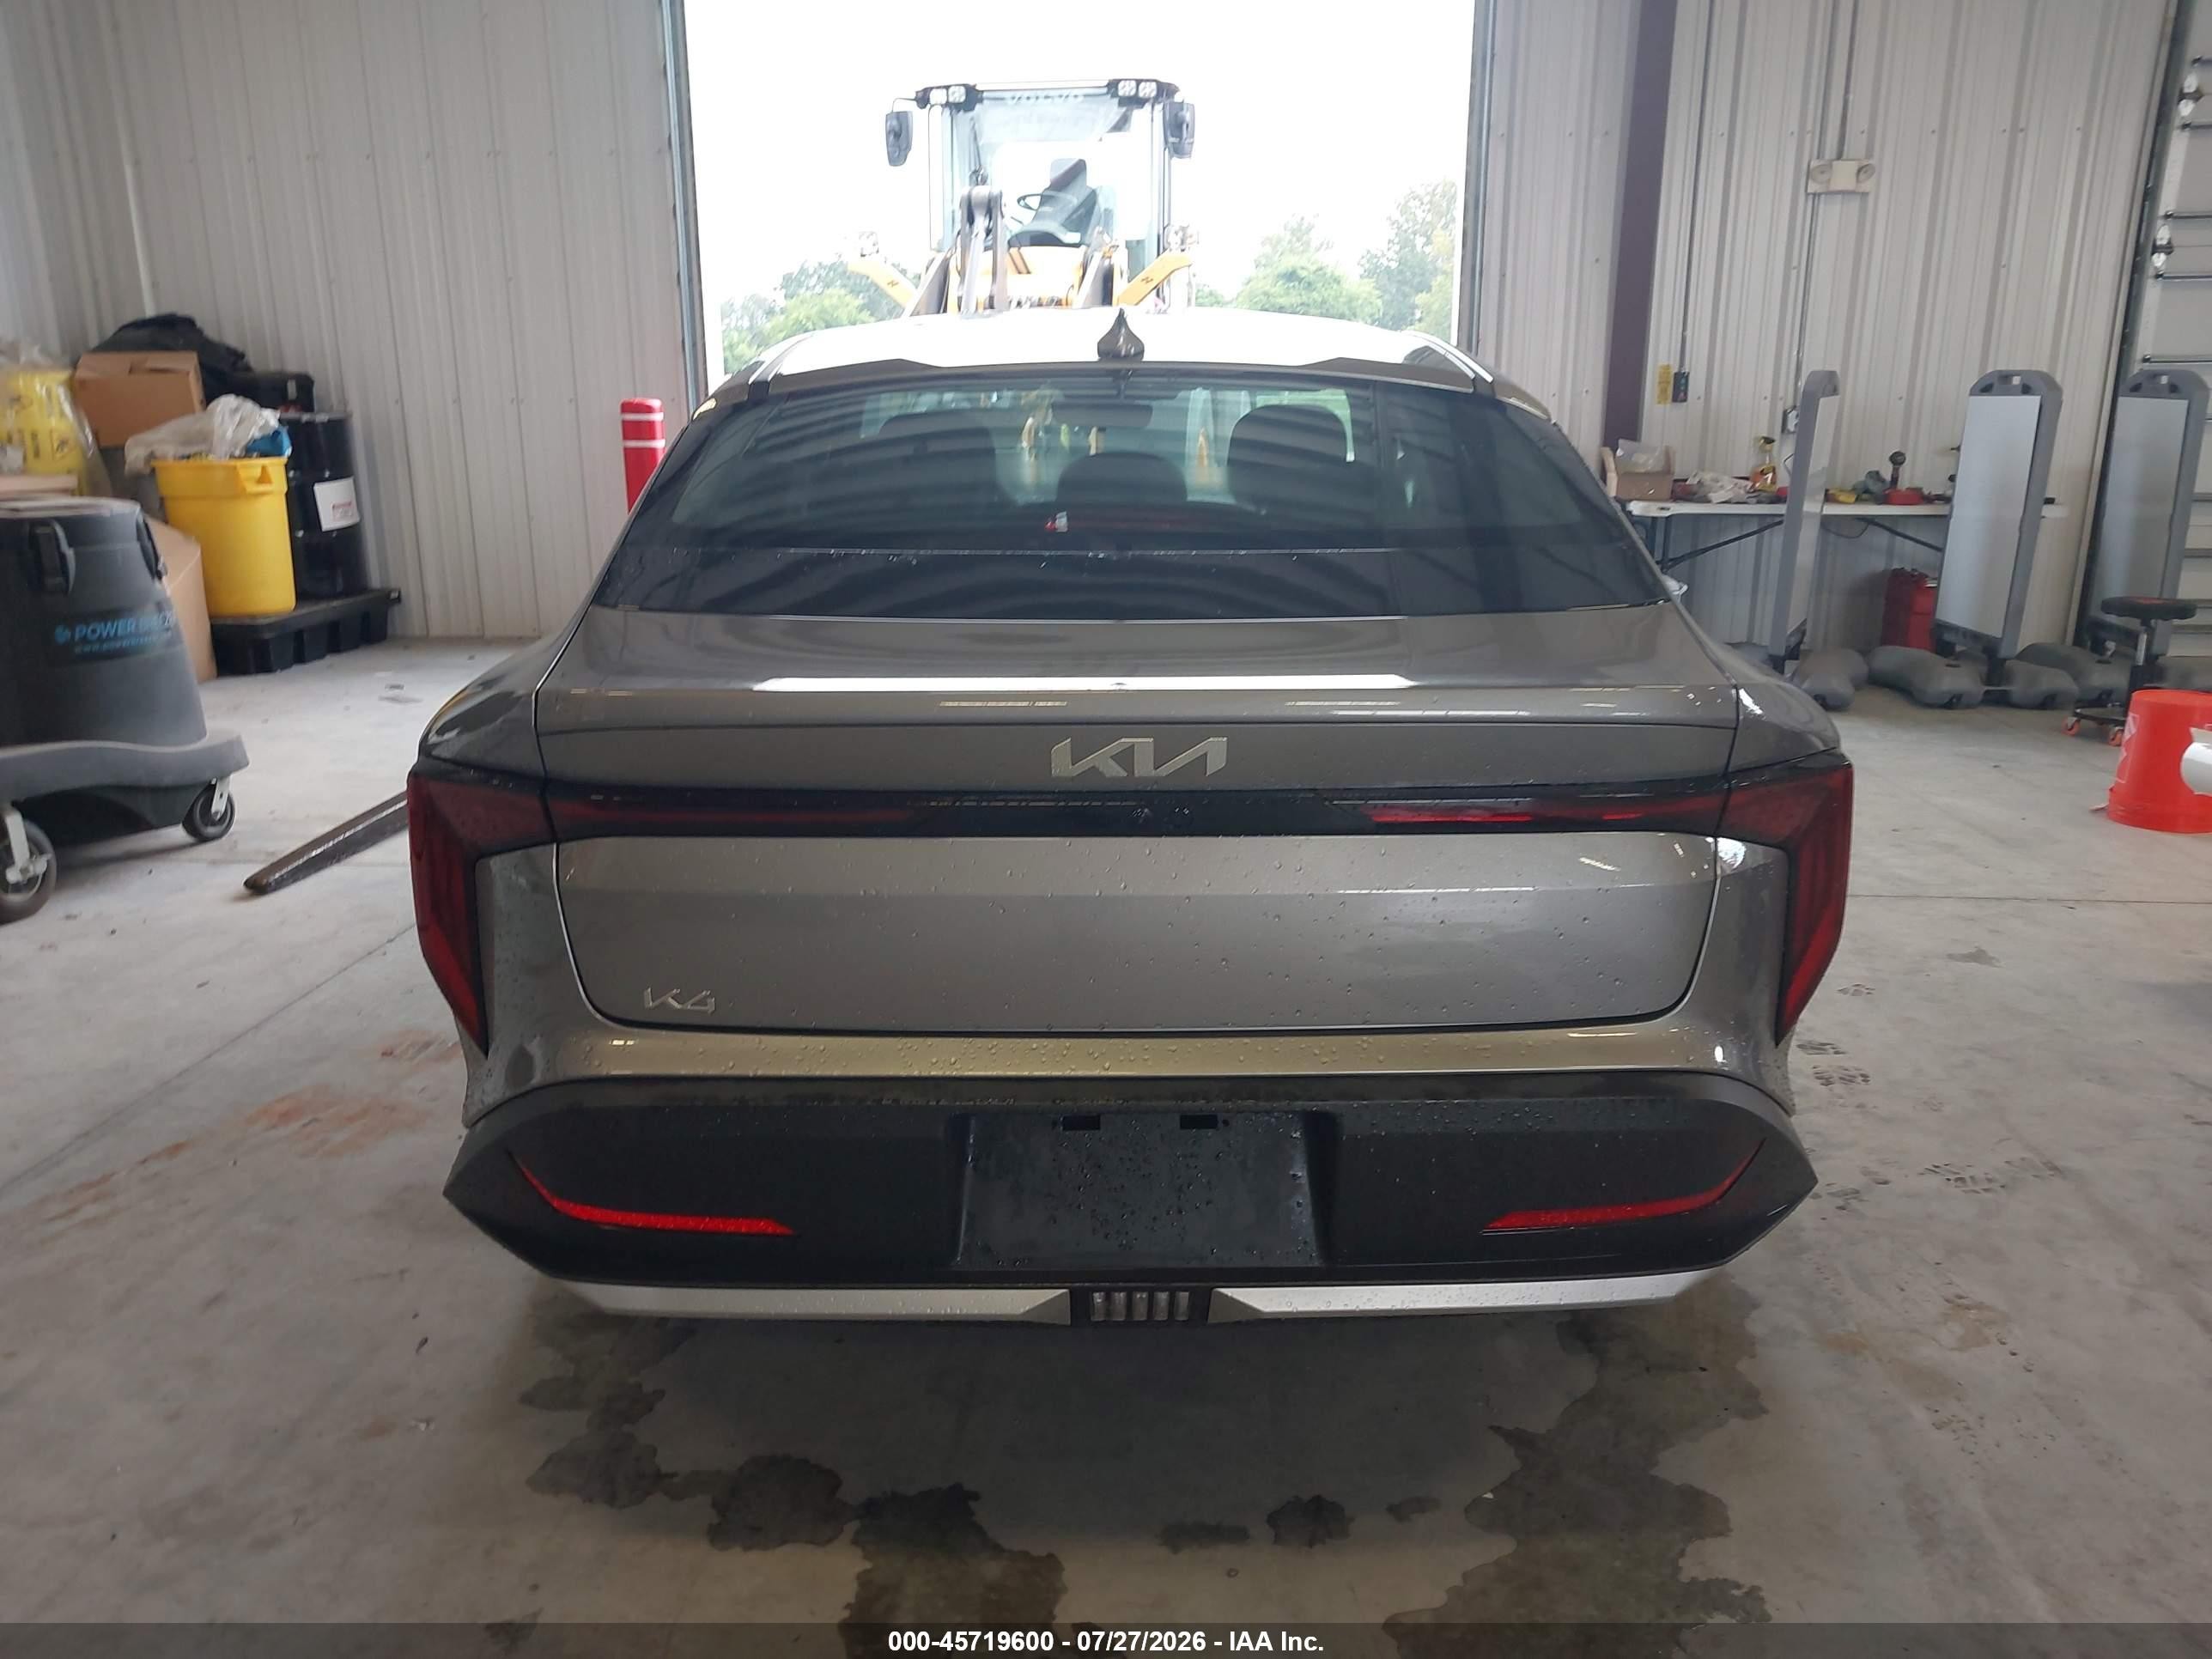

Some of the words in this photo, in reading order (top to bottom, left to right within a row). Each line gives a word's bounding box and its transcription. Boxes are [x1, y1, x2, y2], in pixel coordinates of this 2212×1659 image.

[1004, 92, 1085, 104] VOLVO
[74, 617, 136, 642] POWER
[1050, 737, 1228, 777] KIA
[643, 987, 715, 1014] K4
